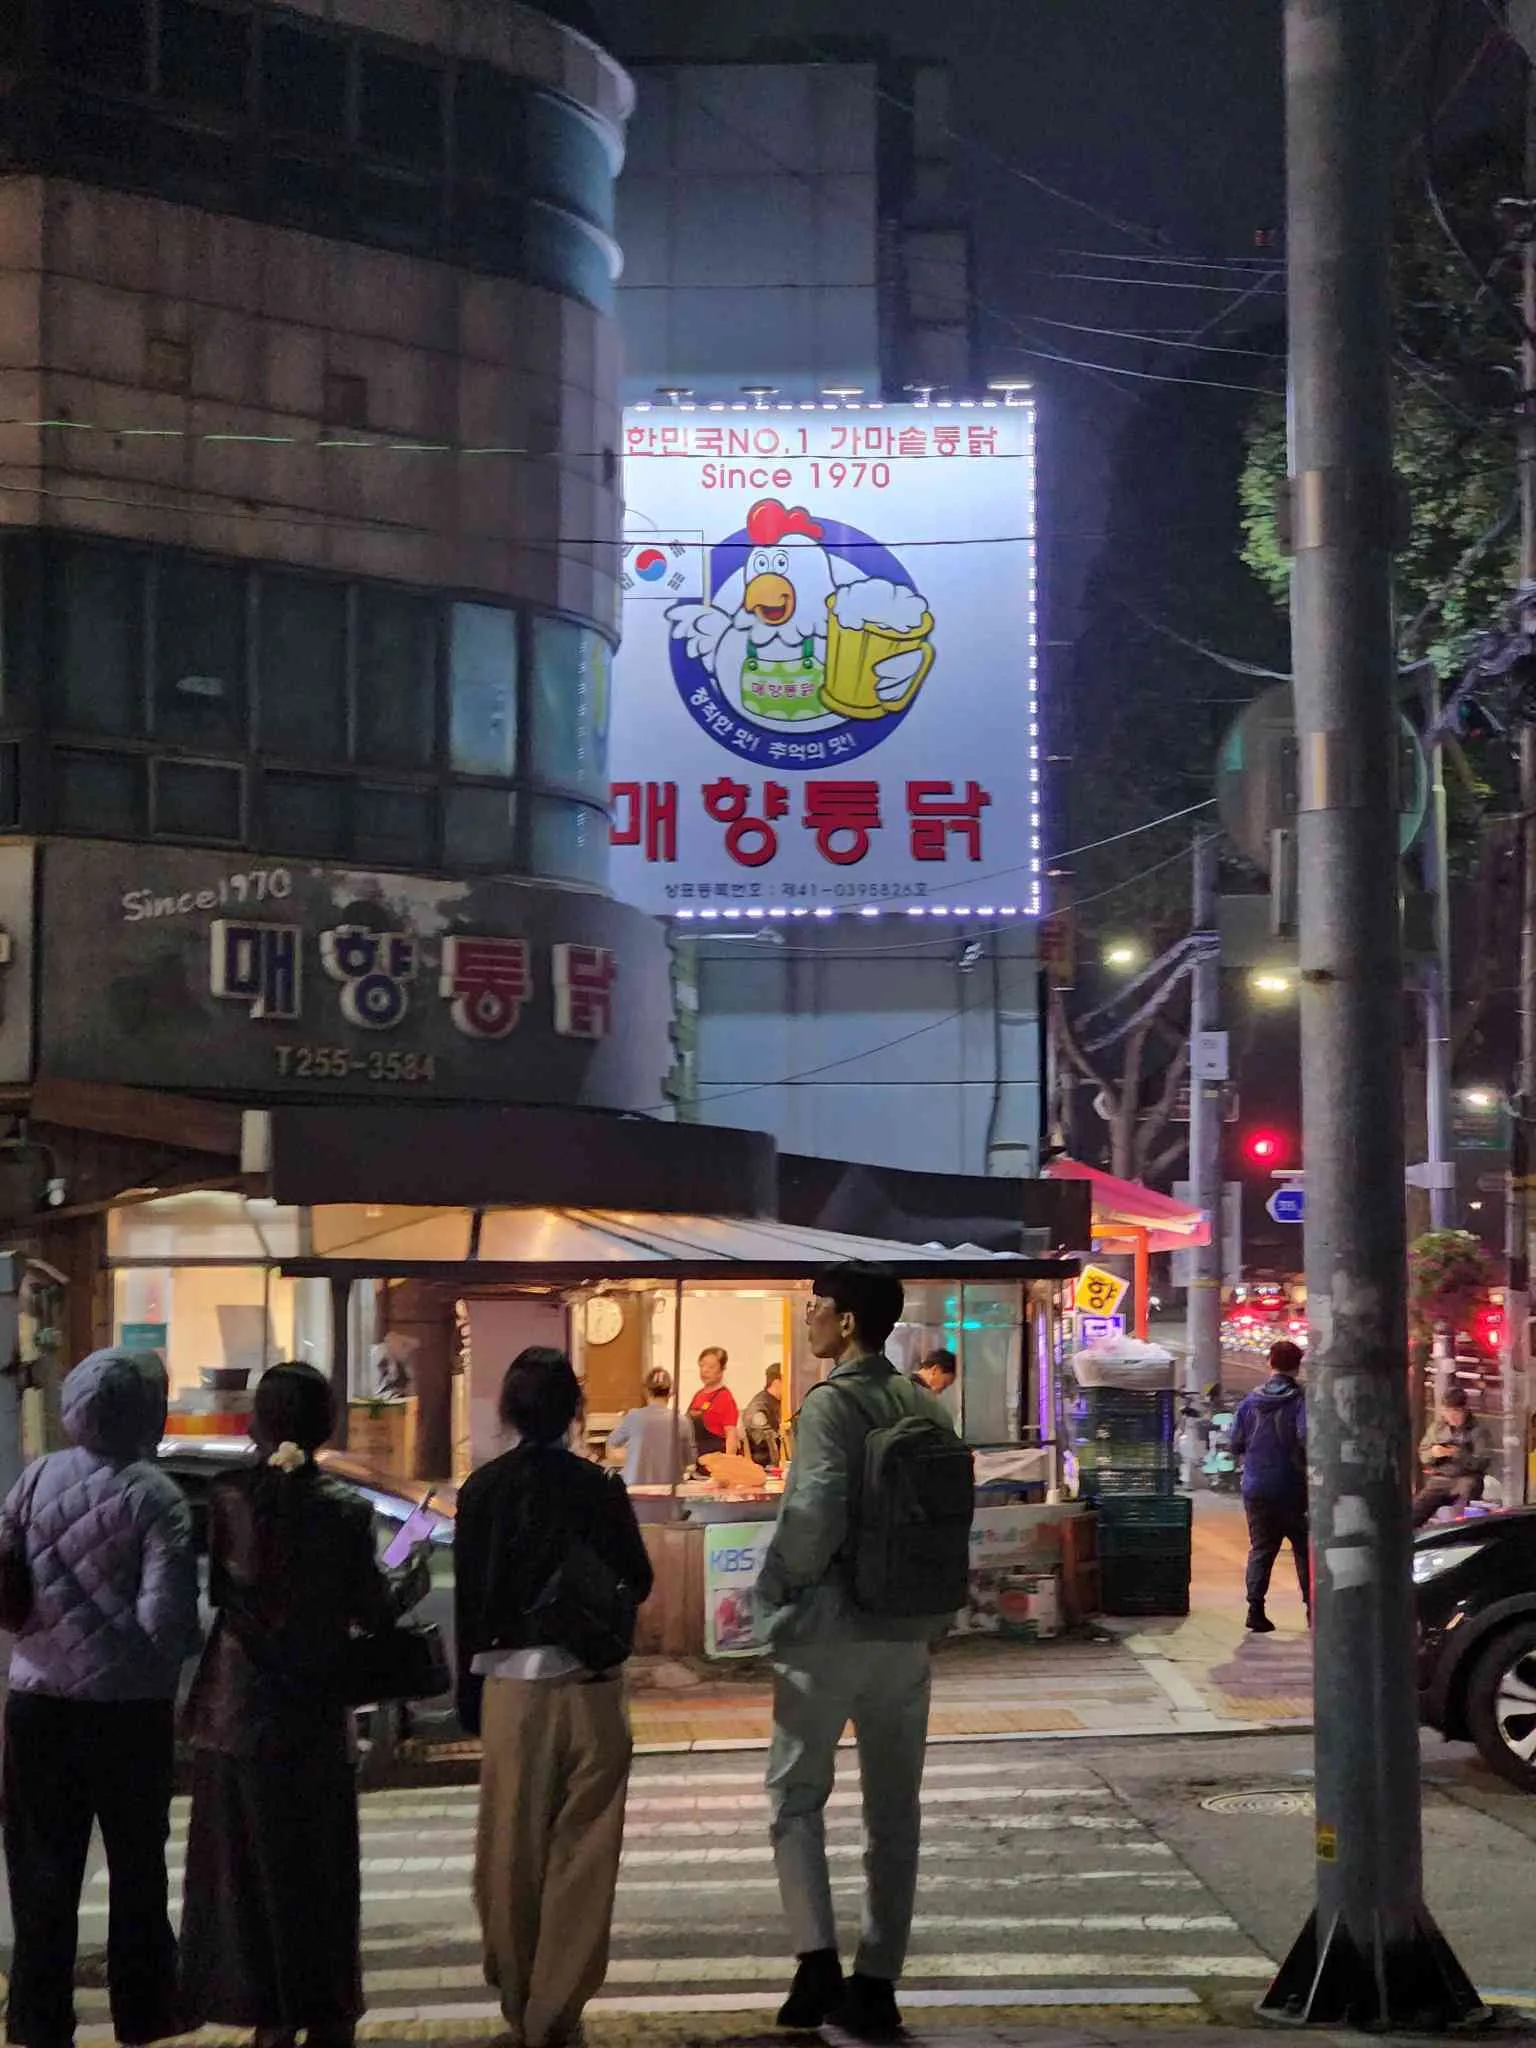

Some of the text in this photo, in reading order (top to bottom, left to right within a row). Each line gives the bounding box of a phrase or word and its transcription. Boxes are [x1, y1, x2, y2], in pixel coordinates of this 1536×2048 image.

[831, 425, 998, 457] 가마솥통닭
[701, 462, 891, 489] Since 1970
[690, 687, 734, 736] 정직한
[768, 741, 826, 761] 추억의
[608, 776, 993, 867] 매향통닭
[210, 918, 619, 1040] 매향통닭
